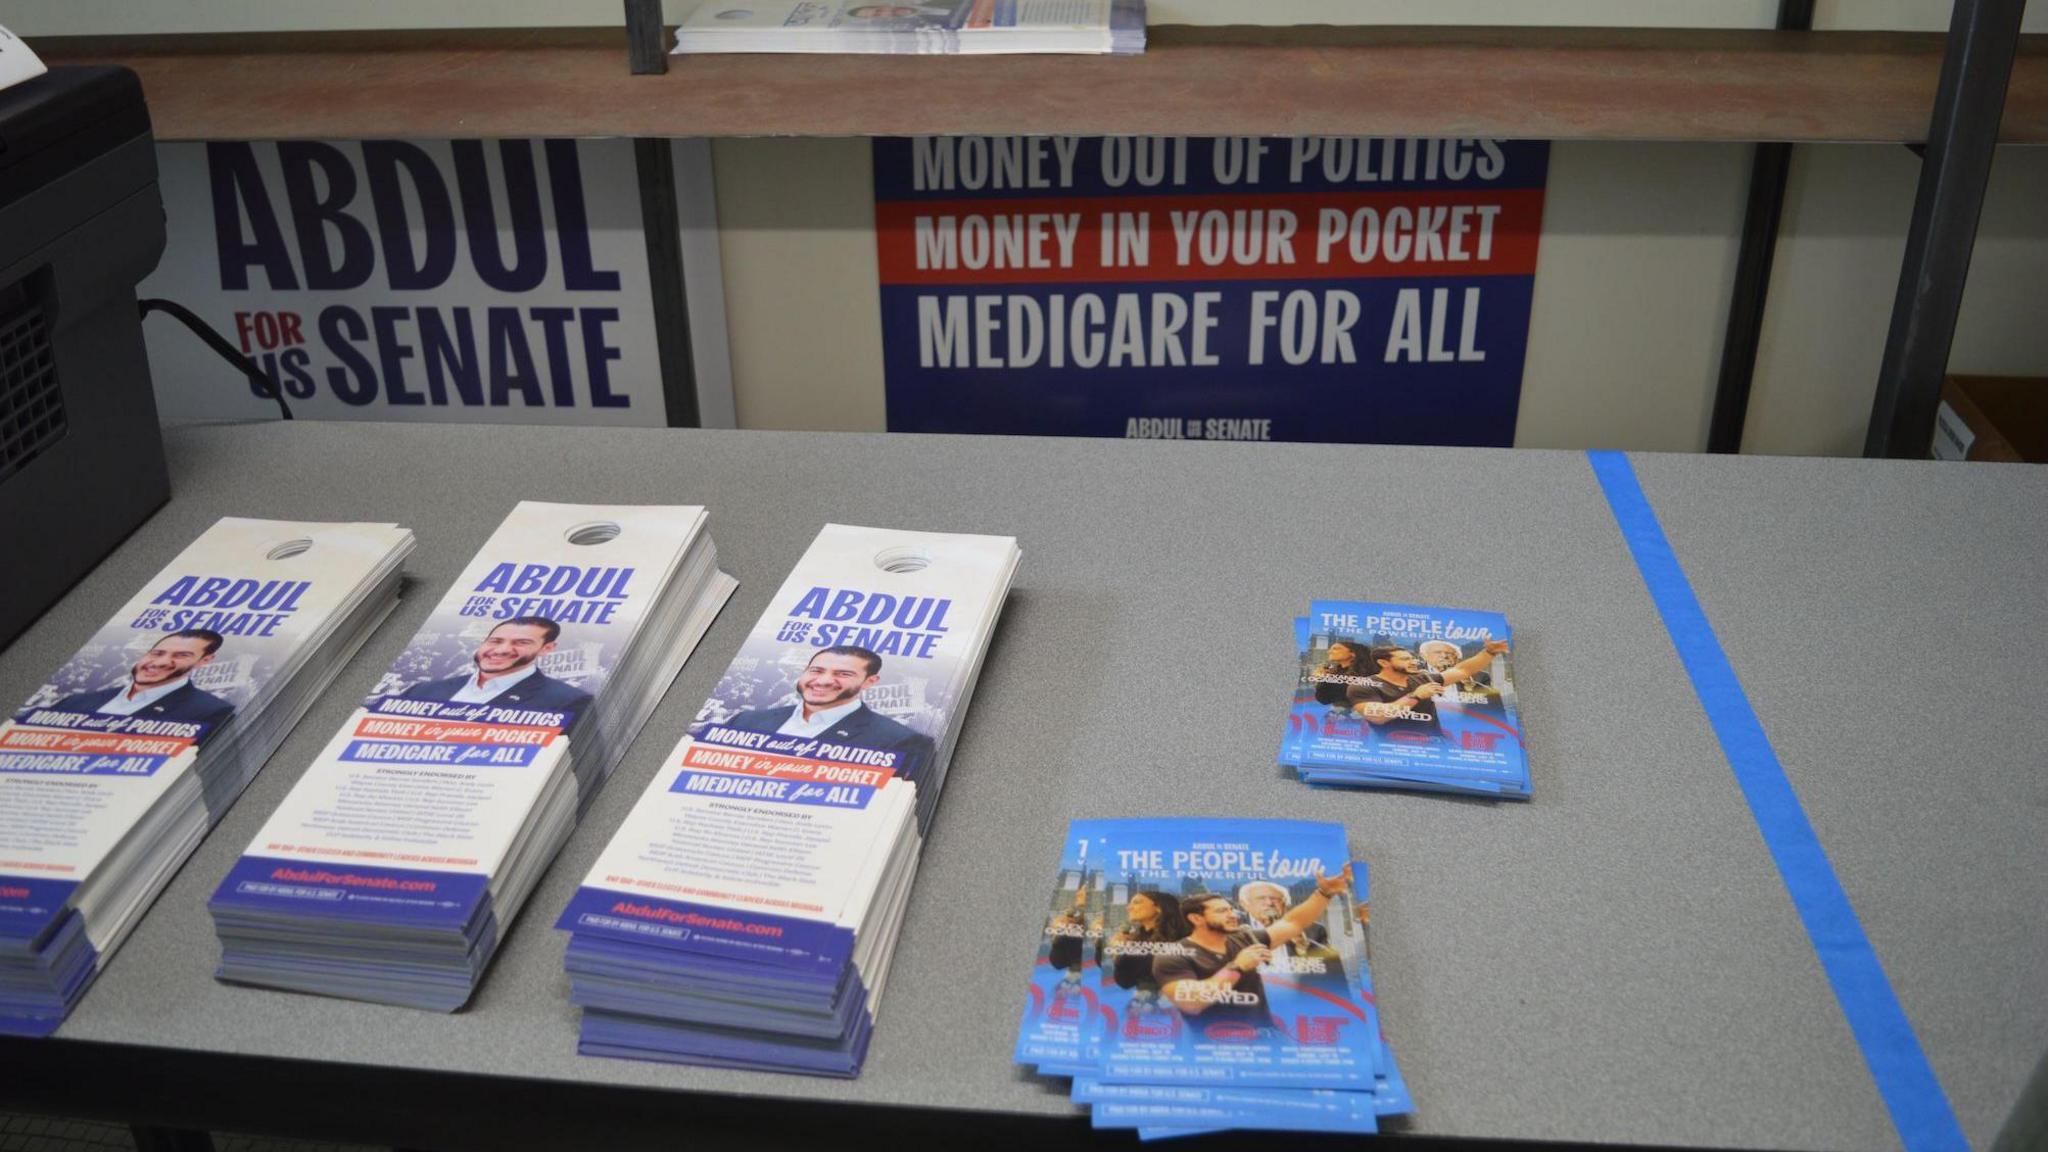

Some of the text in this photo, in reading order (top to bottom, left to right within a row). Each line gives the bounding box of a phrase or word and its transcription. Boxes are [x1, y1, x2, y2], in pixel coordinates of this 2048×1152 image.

[912, 137, 1506, 190] MONEY OUT OF POLITICS
[206, 138, 621, 293] ABDUL
[915, 205, 1501, 269] MONEY IN YOUR POCKET
[235, 311, 305, 353] FOR
[918, 287, 1486, 368] MEDICARE FOR ALL
[318, 305, 631, 408] SENATE
[247, 348, 316, 399] US
[1125, 418, 1184, 439] ABDUL
[1205, 418, 1271, 440] SENATE
[150, 575, 312, 613] ABDUL
[474, 562, 635, 599] ABDUL
[459, 604, 491, 617] US
[467, 596, 497, 606] FOR
[493, 597, 622, 625] SENATE
[788, 586, 952, 632] ABDUL
[130, 617, 163, 630] US
[162, 609, 288, 637] SENATE
[776, 629, 809, 643] US
[782, 620, 813, 632] FOR
[1321, 613, 1492, 641] THE PEOPLE tour
[1368, 629, 1445, 640] POWERFUL
[810, 623, 942, 659] SENATE
[26, 710, 86, 727] MONEY
[125, 719, 201, 738] POLITICS
[378, 699, 442, 717] MONEY
[488, 709, 565, 727] POLITICS
[5, 732, 66, 746] MONEY
[116, 739, 184, 754] POCKET
[362, 720, 422, 737] MONEY
[482, 727, 550, 745] POCKET
[355, 743, 524, 763] MEDICARE for ALL
[705, 727, 896, 767] MONEY out of POLITICS
[0, 754, 89, 771] MEDICARE
[117, 757, 153, 773] ALL
[690, 750, 883, 786] MONEY in your POCKET
[686, 774, 860, 804] MEDICARE for ALL
[1117, 849, 1325, 878] THE PEOPLE tour
[1140, 870, 1169, 878] THE
[1177, 871, 1267, 880] POWERFUL
[270, 867, 436, 892] AbdulForSenate.com
[612, 902, 783, 937] AbdulForSenate.com
